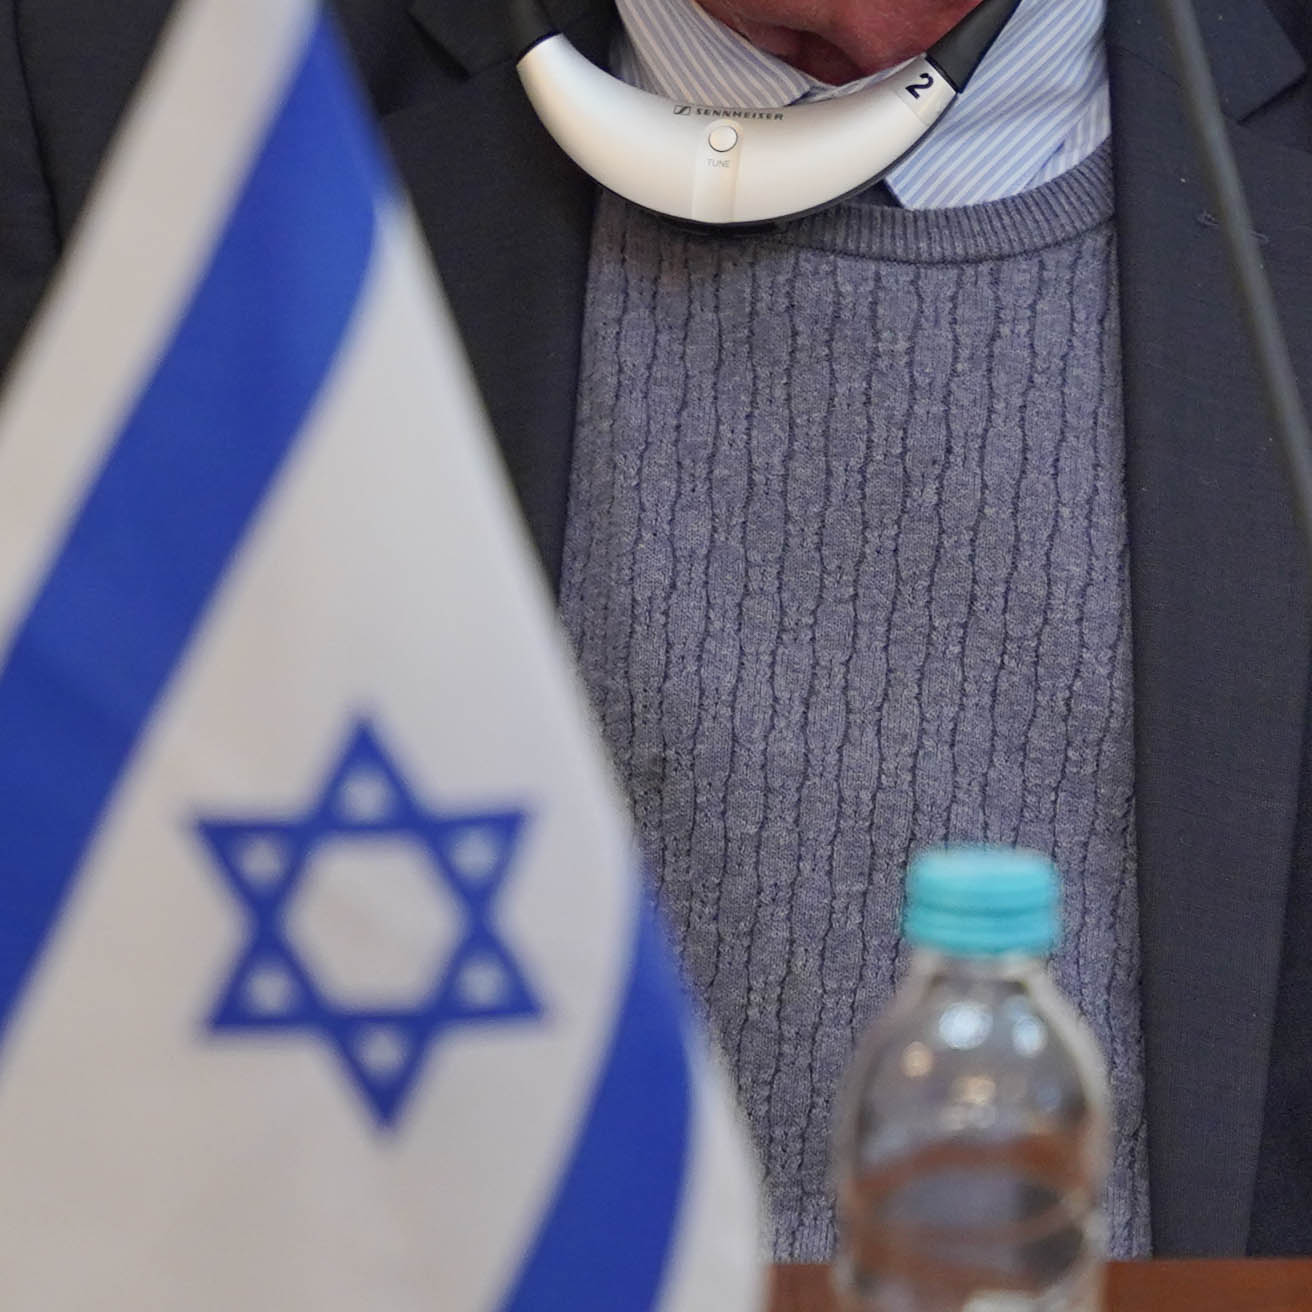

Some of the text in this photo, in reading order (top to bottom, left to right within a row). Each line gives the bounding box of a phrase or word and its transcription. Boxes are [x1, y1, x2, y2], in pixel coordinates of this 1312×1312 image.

[904, 71, 936, 101] 2
[694, 106, 785, 121] SENNHEISER
[706, 158, 731, 168] TUNE
